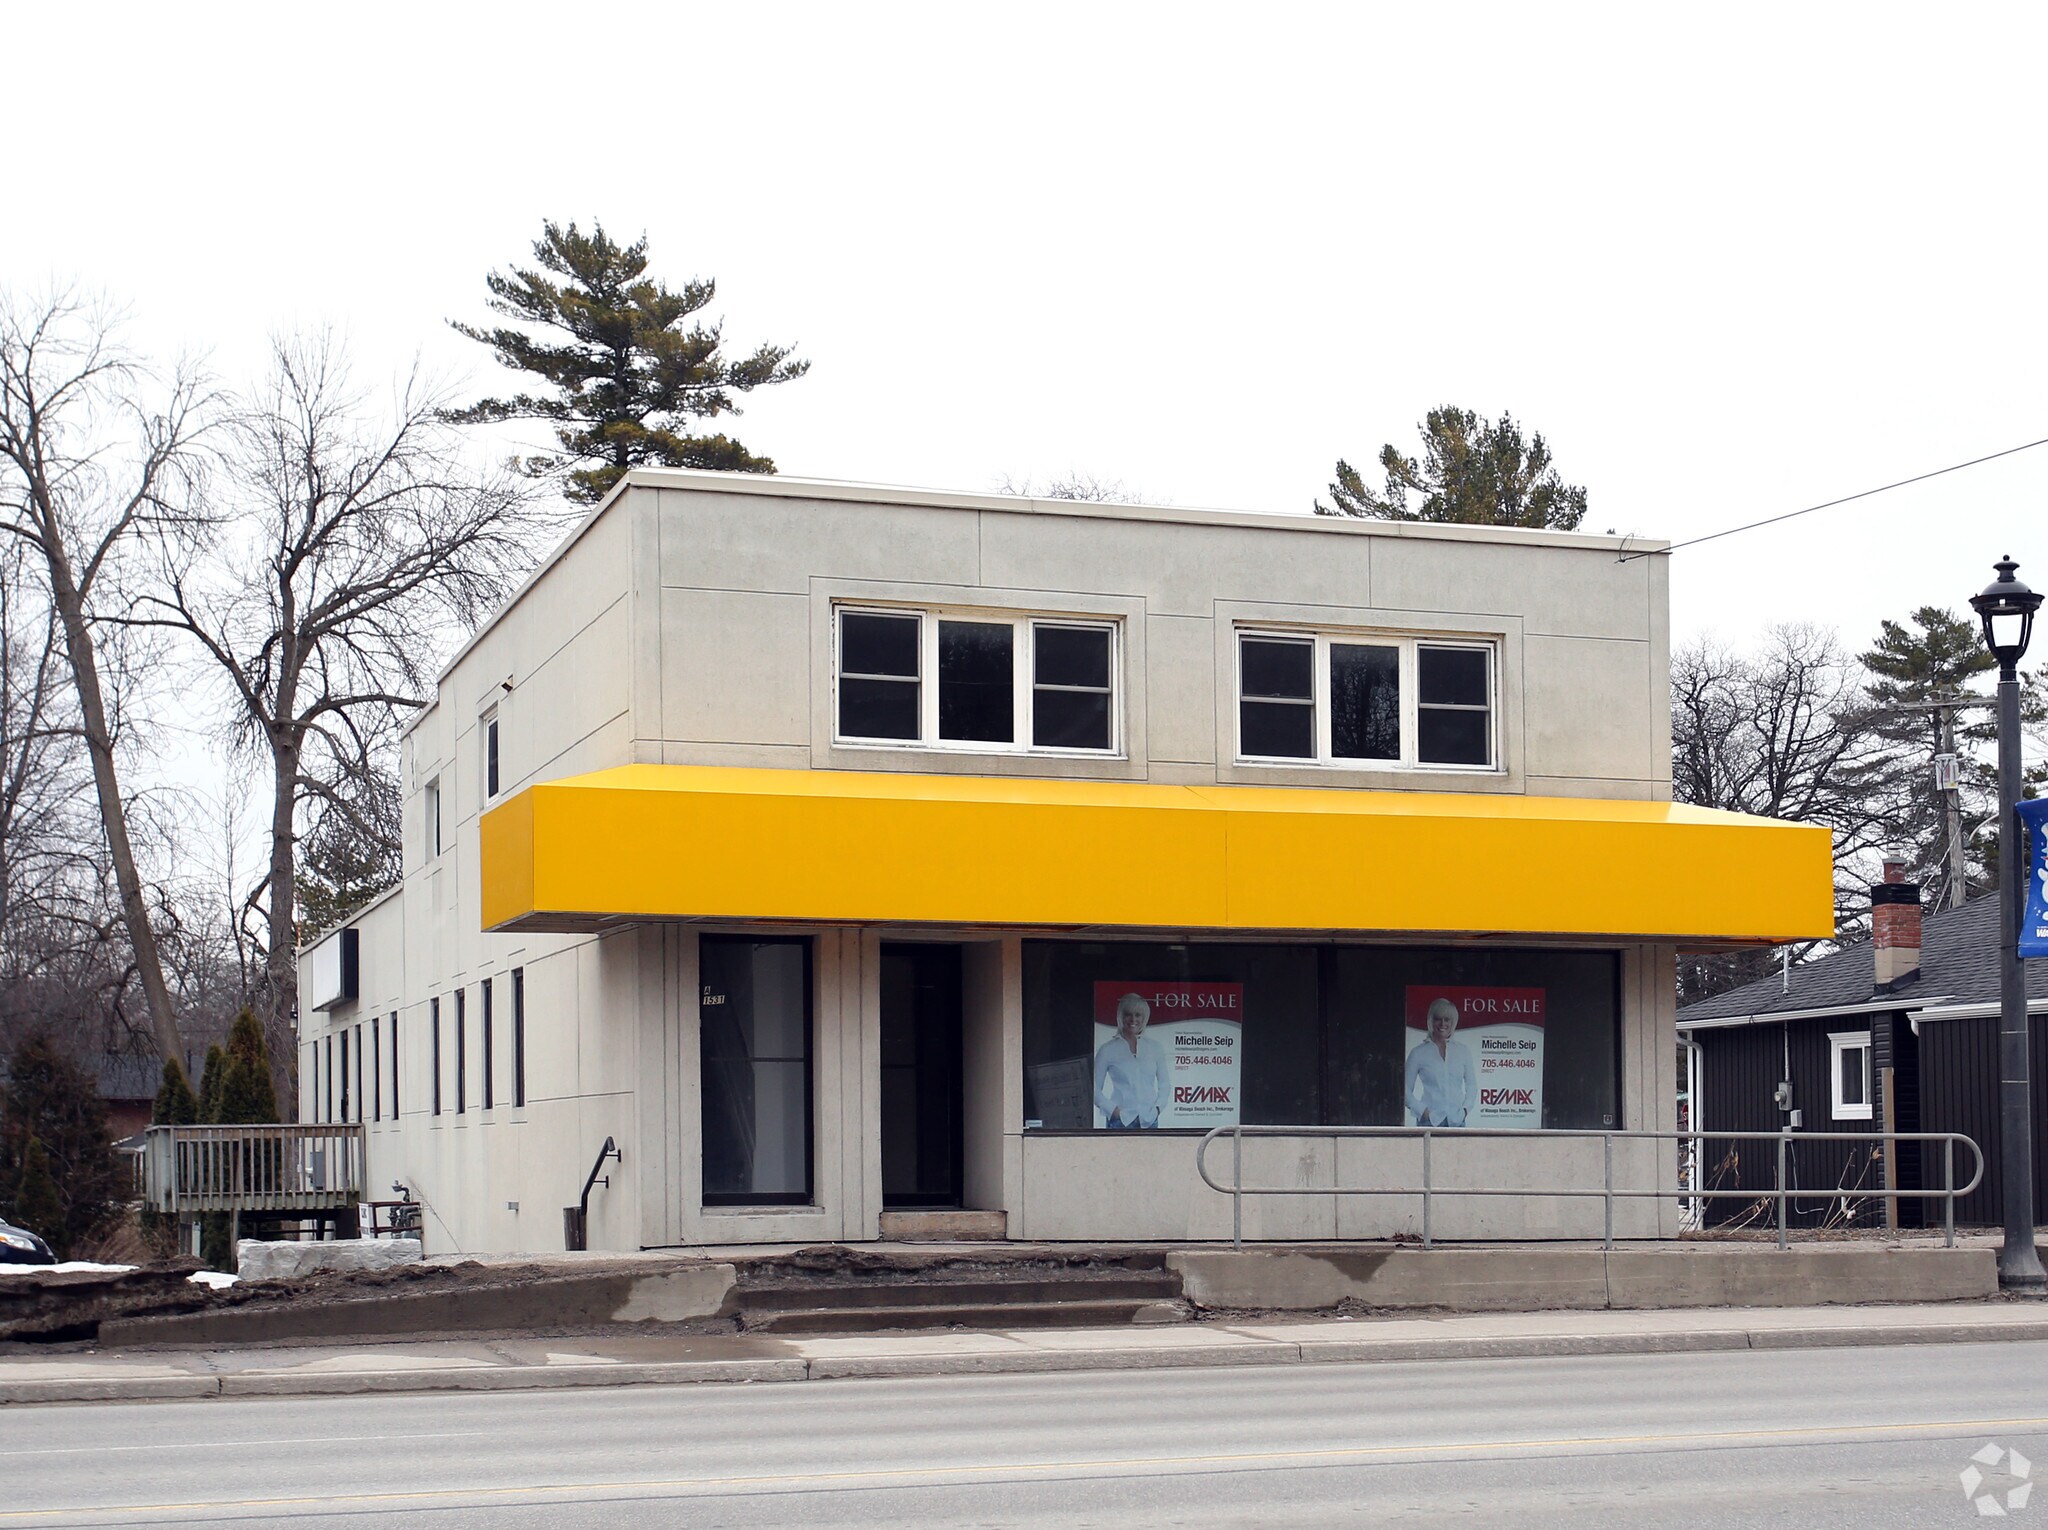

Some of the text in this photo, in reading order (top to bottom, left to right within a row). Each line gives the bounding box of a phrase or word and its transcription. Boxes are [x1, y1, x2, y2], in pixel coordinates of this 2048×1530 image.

[704, 995, 724, 1004] 1531
[1155, 993, 1237, 1008] FOR SALE
[1463, 998, 1540, 1014] FOR SALE
[1175, 1036, 1234, 1047] Michelle Seip
[1481, 1040, 1537, 1051] Michelle Seip
[1175, 1056, 1233, 1065] 705.446.4046
[1481, 1059, 1536, 1068] 705.446.4046
[1174, 1086, 1232, 1104] RE/MAX
[1480, 1088, 1534, 1106] RE/MAX
